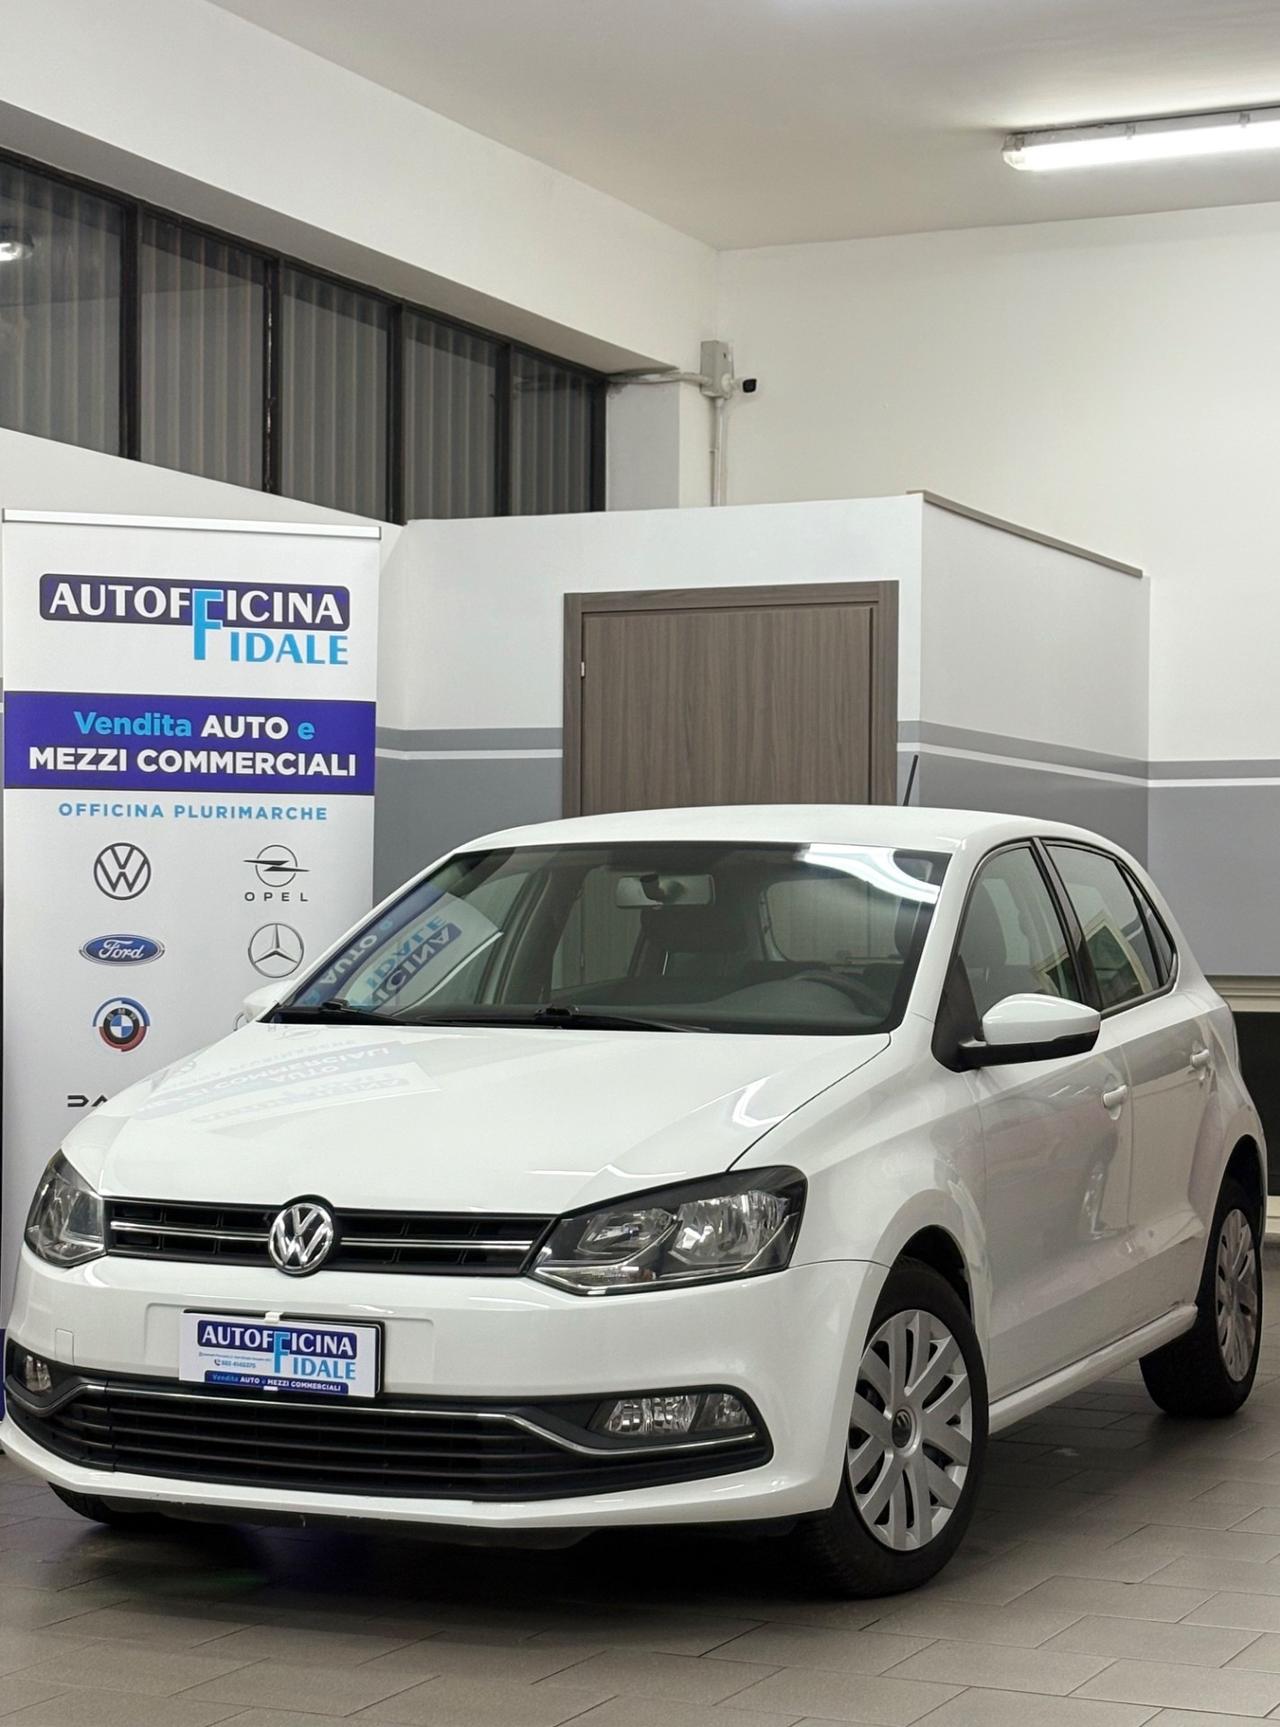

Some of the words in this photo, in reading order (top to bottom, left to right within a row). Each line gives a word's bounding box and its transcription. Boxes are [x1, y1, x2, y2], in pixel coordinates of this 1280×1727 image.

[49, 582, 344, 628] AUTOFFICINA
[74, 711, 192, 737] Vendita
[200, 715, 289, 740] AUTO
[297, 721, 315, 740] e
[29, 747, 127, 772] MEZZI
[136, 749, 356, 776] COMMERCIALI
[59, 803, 164, 818] OFFICINA
[174, 805, 328, 820] PLURIMARCHE
[244, 892, 308, 902] OPEL
[99, 939, 144, 959] Ford
[201, 1325, 354, 1356] AUTOFFICINA
[240, 1376, 260, 1385] AUTO
[267, 1379, 290, 1387] MEZZI
[290, 1381, 341, 1392] COMMERCIALI
